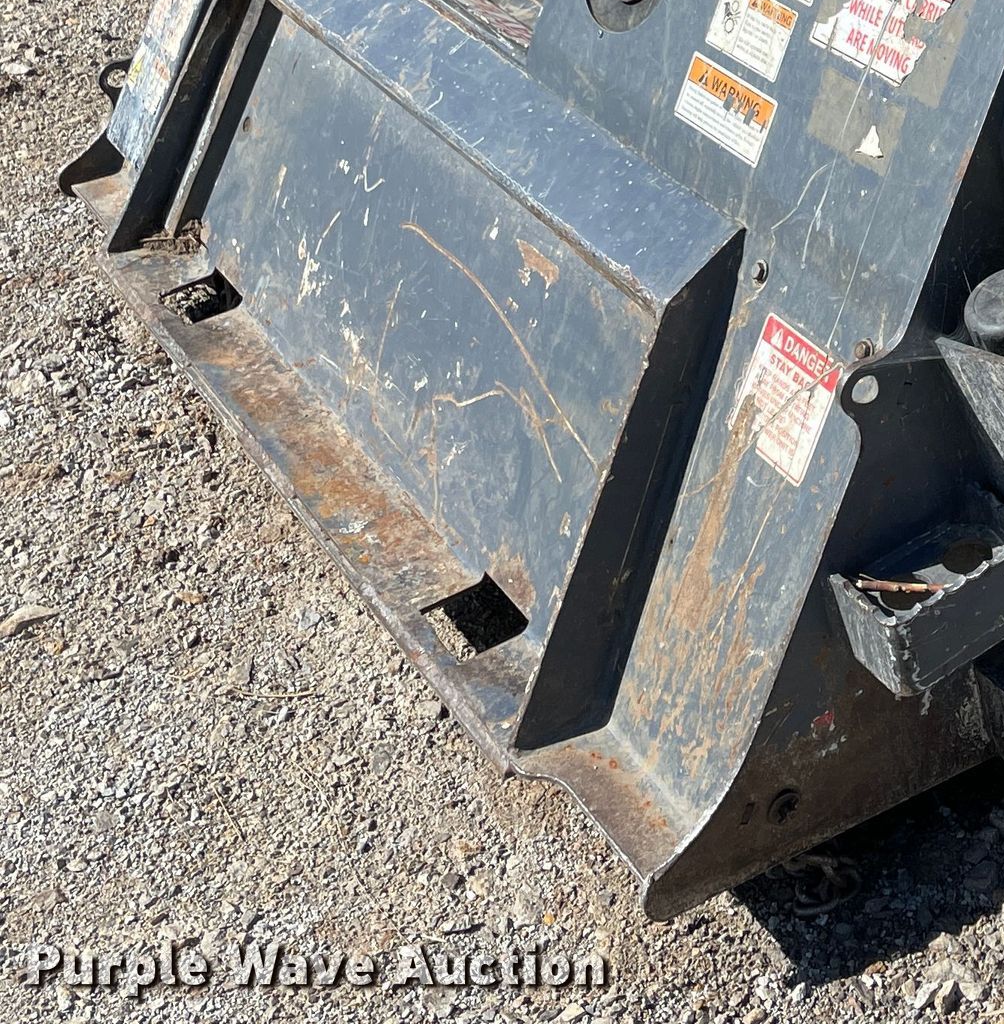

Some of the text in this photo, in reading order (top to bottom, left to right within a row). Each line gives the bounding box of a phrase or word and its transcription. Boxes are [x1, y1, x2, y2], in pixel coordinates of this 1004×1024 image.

[846, 28, 866, 52] ARE
[769, 353, 813, 391] STAY BAC
